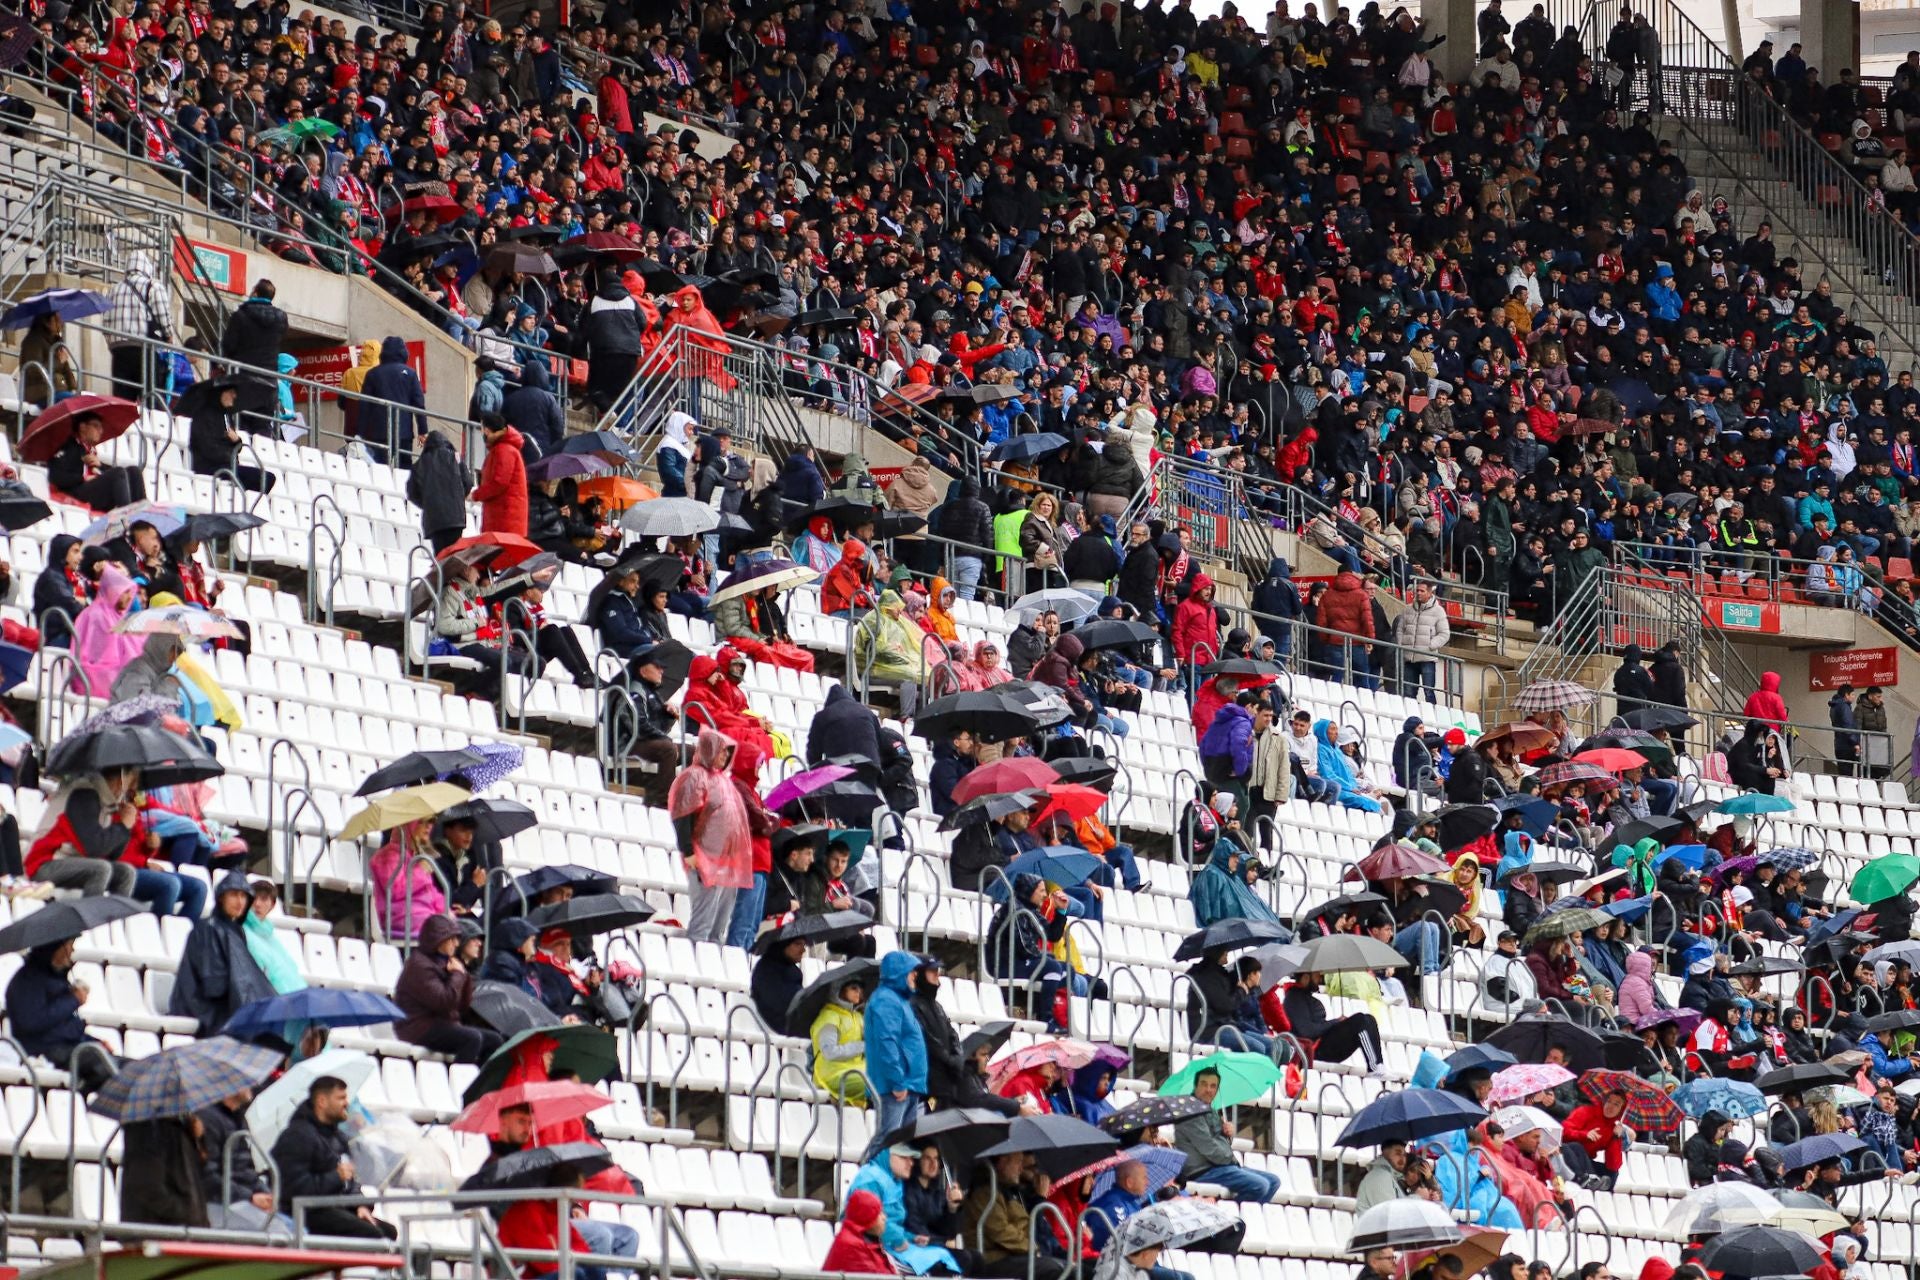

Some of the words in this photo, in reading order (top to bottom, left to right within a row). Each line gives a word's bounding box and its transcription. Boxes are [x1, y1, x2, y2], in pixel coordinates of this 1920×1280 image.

[300, 354, 339, 365] RIBUNA
[1728, 605, 1753, 618] Salida
[1823, 655, 1848, 664] Tribuna
[1848, 652, 1883, 662] Preferente
[1839, 662, 1868, 671] Superior
